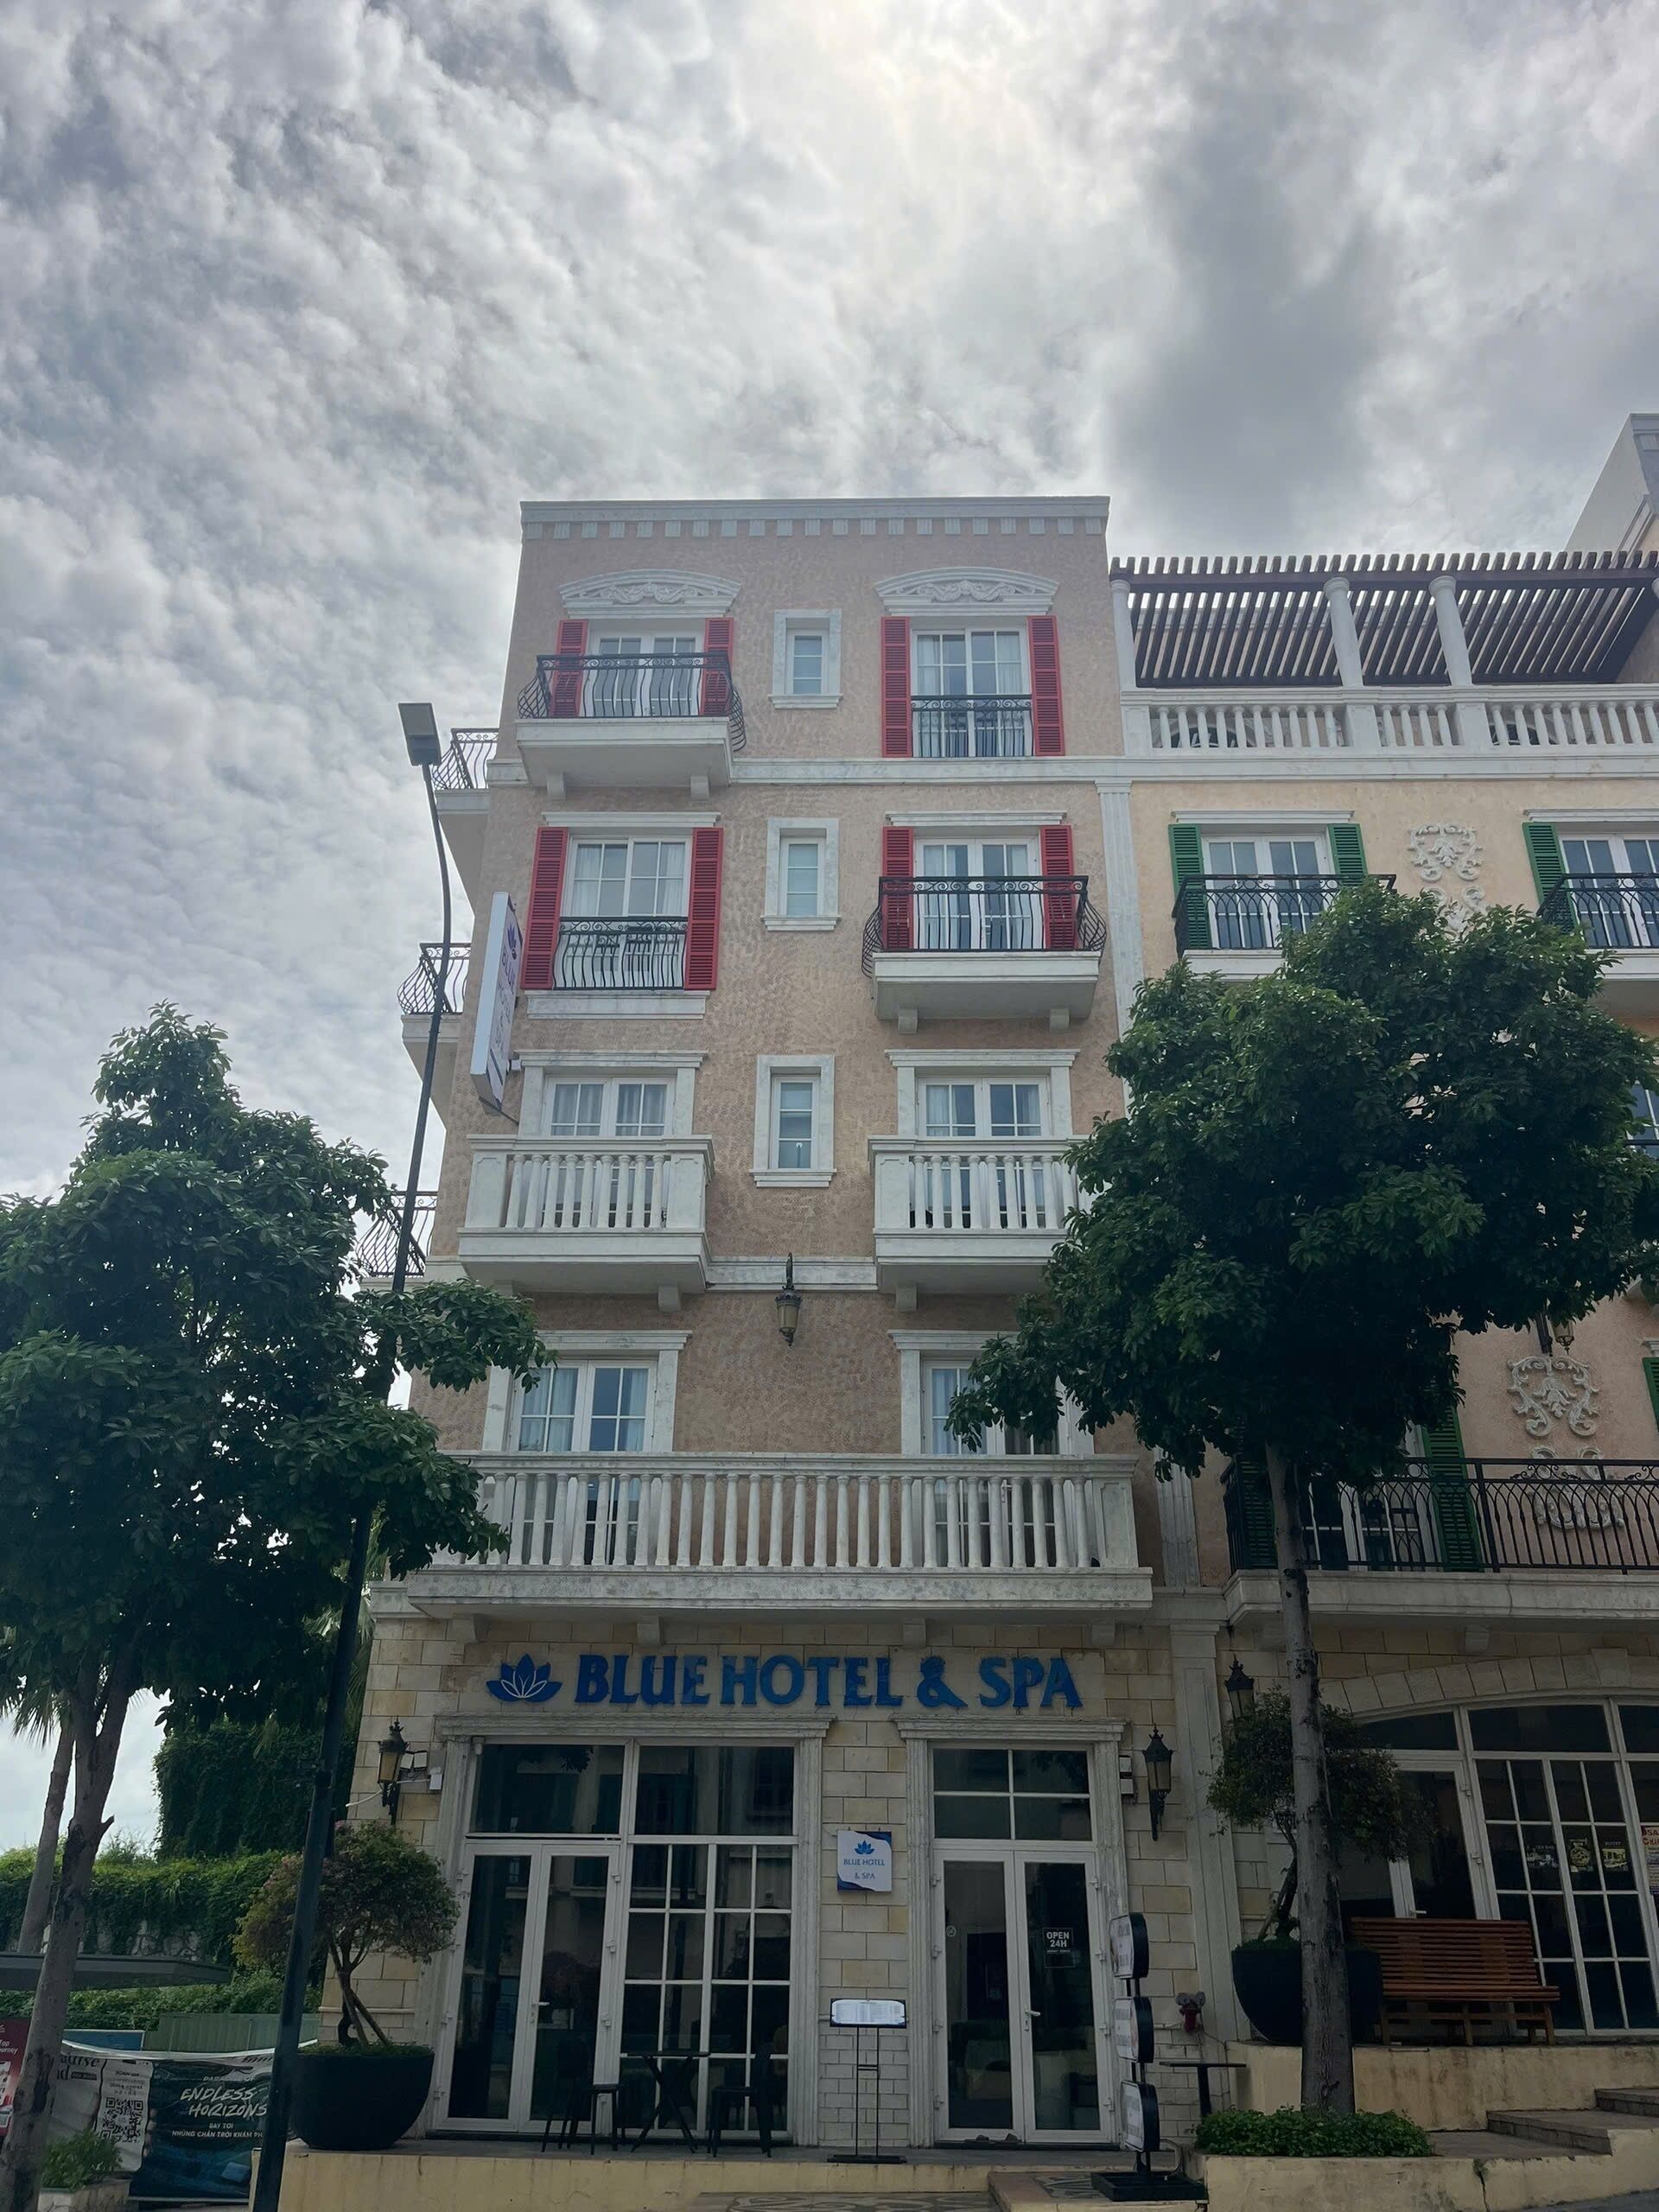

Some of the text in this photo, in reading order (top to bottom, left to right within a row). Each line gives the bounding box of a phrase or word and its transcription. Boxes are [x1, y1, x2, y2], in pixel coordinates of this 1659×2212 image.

[574, 1654, 1083, 1707] BLUE HOTEL & SPA
[1046, 1931, 1070, 1940] OPEN
[1050, 1939, 1067, 1948] 24H
[180, 2086, 256, 2102] ENDLESS
[188, 2102, 267, 2119] HORIZONS
